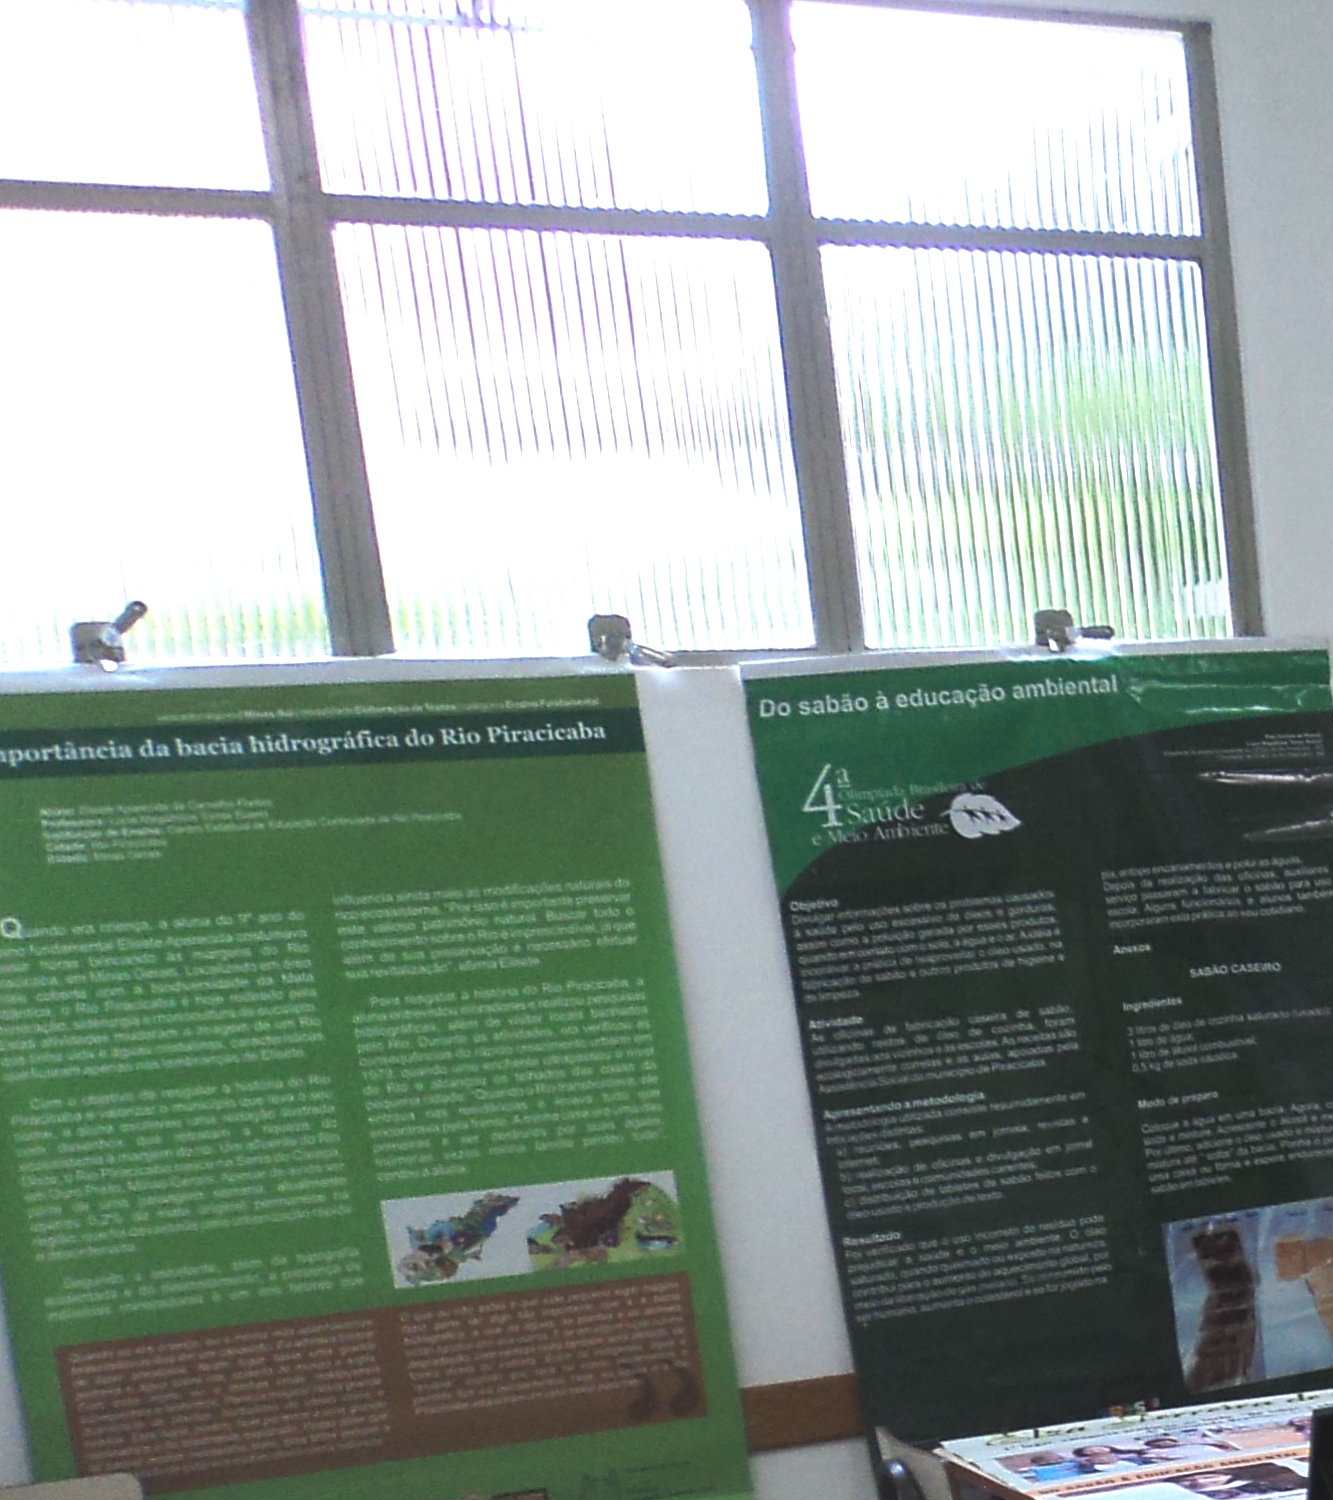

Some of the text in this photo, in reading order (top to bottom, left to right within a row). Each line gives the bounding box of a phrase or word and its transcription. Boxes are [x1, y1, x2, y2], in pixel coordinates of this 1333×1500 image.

[756, 675, 1119, 719] Do sabão à educação ambiental
[137, 738, 171, 758] da
[174, 735, 244, 756] bacia
[248, 729, 400, 756] hidrográfica
[403, 727, 435, 747] do
[439, 726, 481, 745] Rio
[486, 721, 606, 742] Piracicaba
[847, 799, 925, 825] Saúde
[812, 822, 949, 846] e Meio Ambiente
[788, 898, 839, 912] Objetivo
[1112, 942, 1151, 955] Anexos
[1188, 959, 1282, 978] SABÃO CASEIRO
[1121, 997, 1183, 1012] Ingredientes
[807, 1016, 864, 1029] Atividade
[1156, 1036, 1167, 1045] de
[1157, 1048, 1169, 1056] de
[1162, 1060, 1174, 1069] de
[822, 1092, 986, 1119] Apresentando a metodologia
[1136, 1090, 1219, 1109] Modo de preparo
[842, 1232, 901, 1246] Resultado
